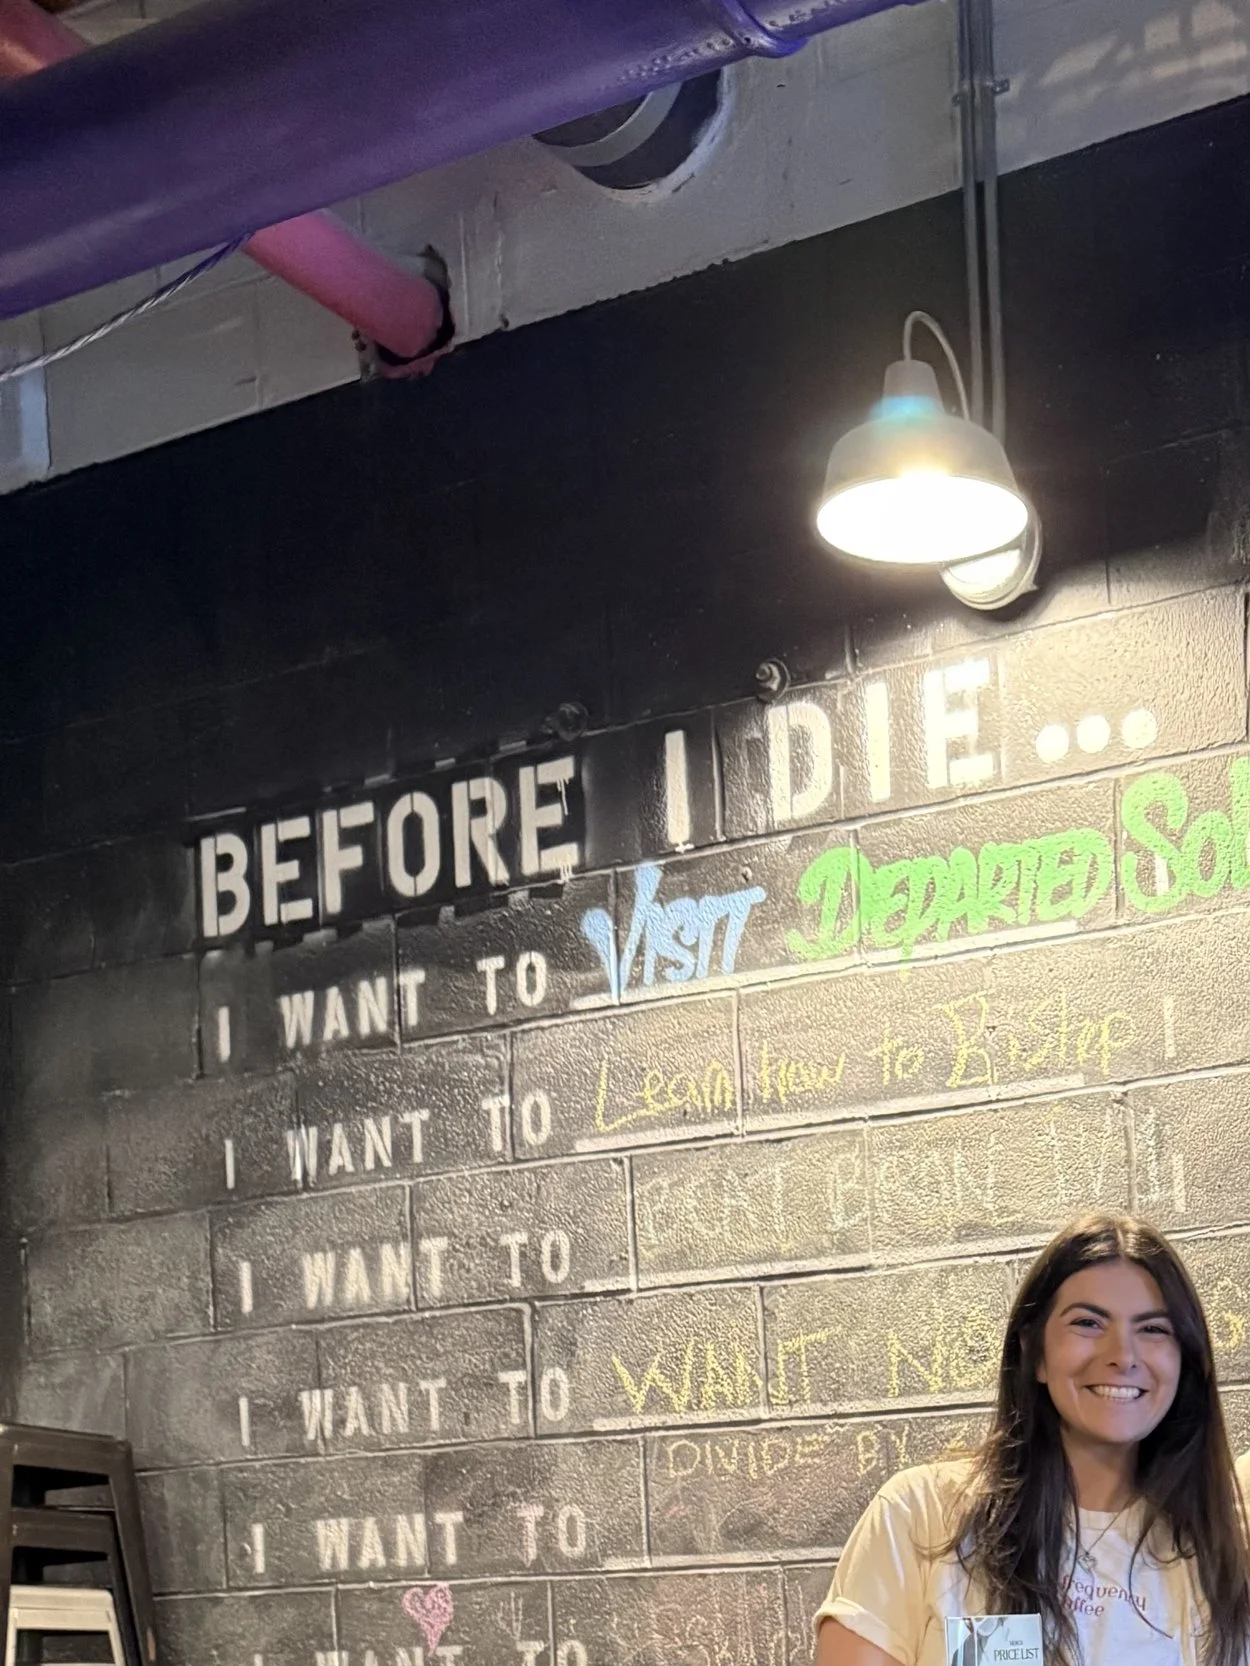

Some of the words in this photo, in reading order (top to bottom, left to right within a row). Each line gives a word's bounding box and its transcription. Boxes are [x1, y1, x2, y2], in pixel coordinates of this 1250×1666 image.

[200, 757, 578, 937] BEFORE
[664, 729, 692, 846] I
[217, 1005, 231, 1063] I
[280, 967, 426, 1049] WANT
[476, 951, 548, 1016] TO
[223, 1138, 236, 1190] I
[284, 1108, 431, 1188] WANT
[481, 1092, 552, 1152] TO
[238, 1259, 253, 1314] I
[302, 1237, 450, 1310] WANT
[500, 1229, 571, 1288] TO
[237, 1395, 252, 1448] I
[299, 1378, 448, 1441] WANT
[497, 1366, 571, 1425] TO
[611, 1329, 833, 1415] WANT
[251, 1522, 266, 1574] I
[314, 1510, 464, 1572] WANT
[514, 1502, 587, 1568] TO
[993, 1649, 1020, 1661] PRICE
[1021, 1648, 1039, 1660] LIST
